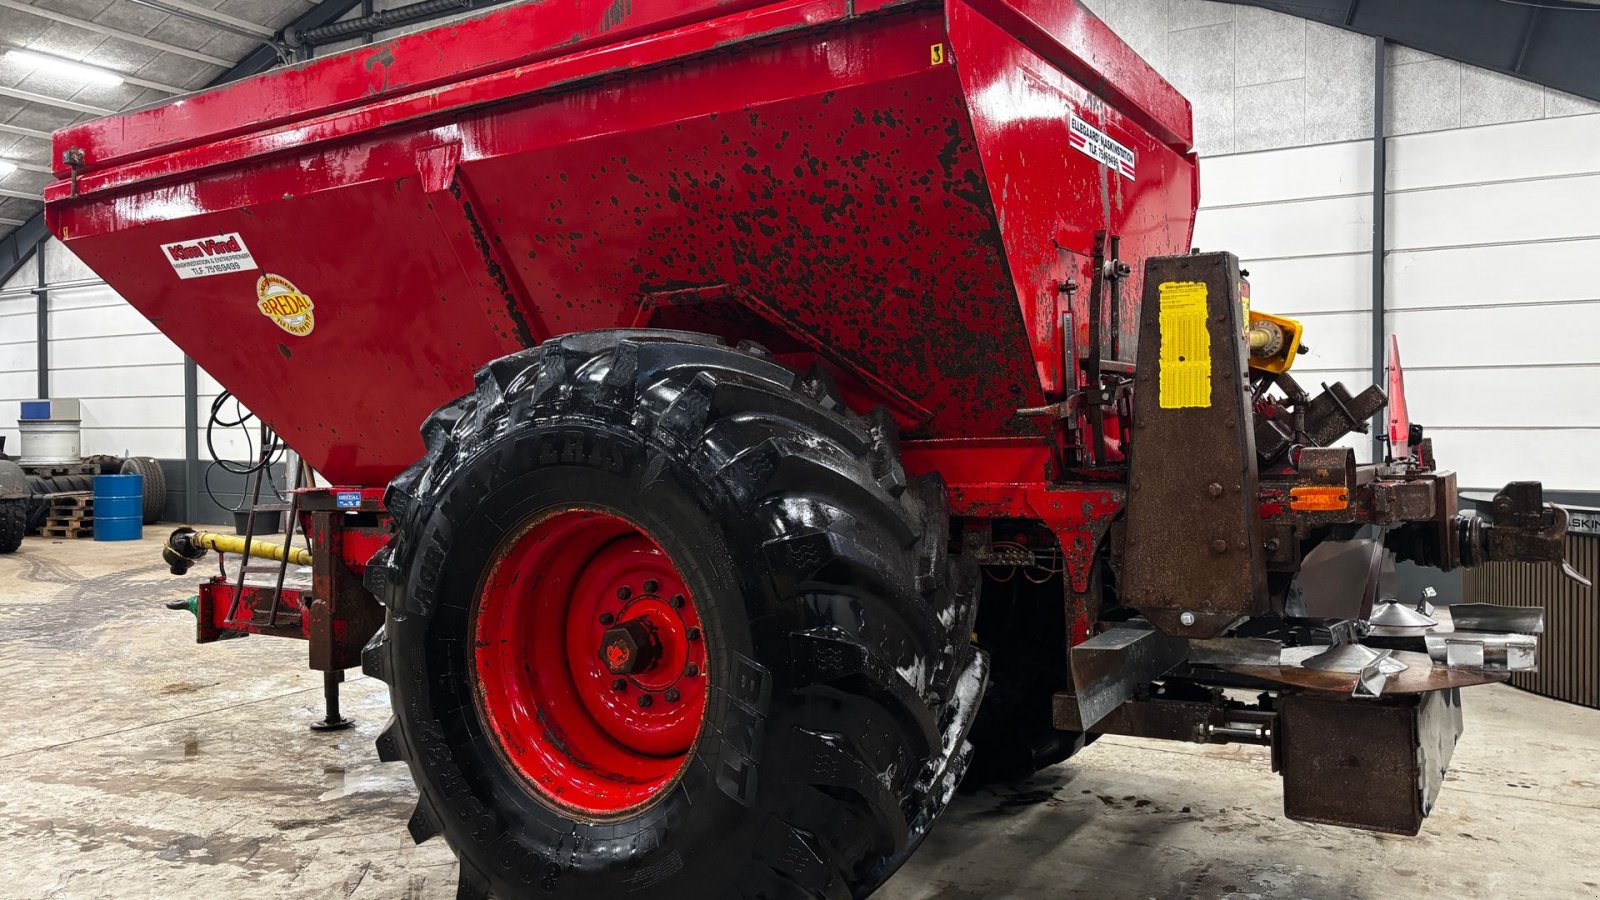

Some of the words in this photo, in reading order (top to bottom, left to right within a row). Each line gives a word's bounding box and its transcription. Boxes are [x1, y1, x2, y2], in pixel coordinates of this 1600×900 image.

[167, 244, 205, 261] Kim
[198, 236, 242, 256] Vind
[261, 295, 311, 316] BREDAL
[1569, 518, 1600, 529] SKIN
